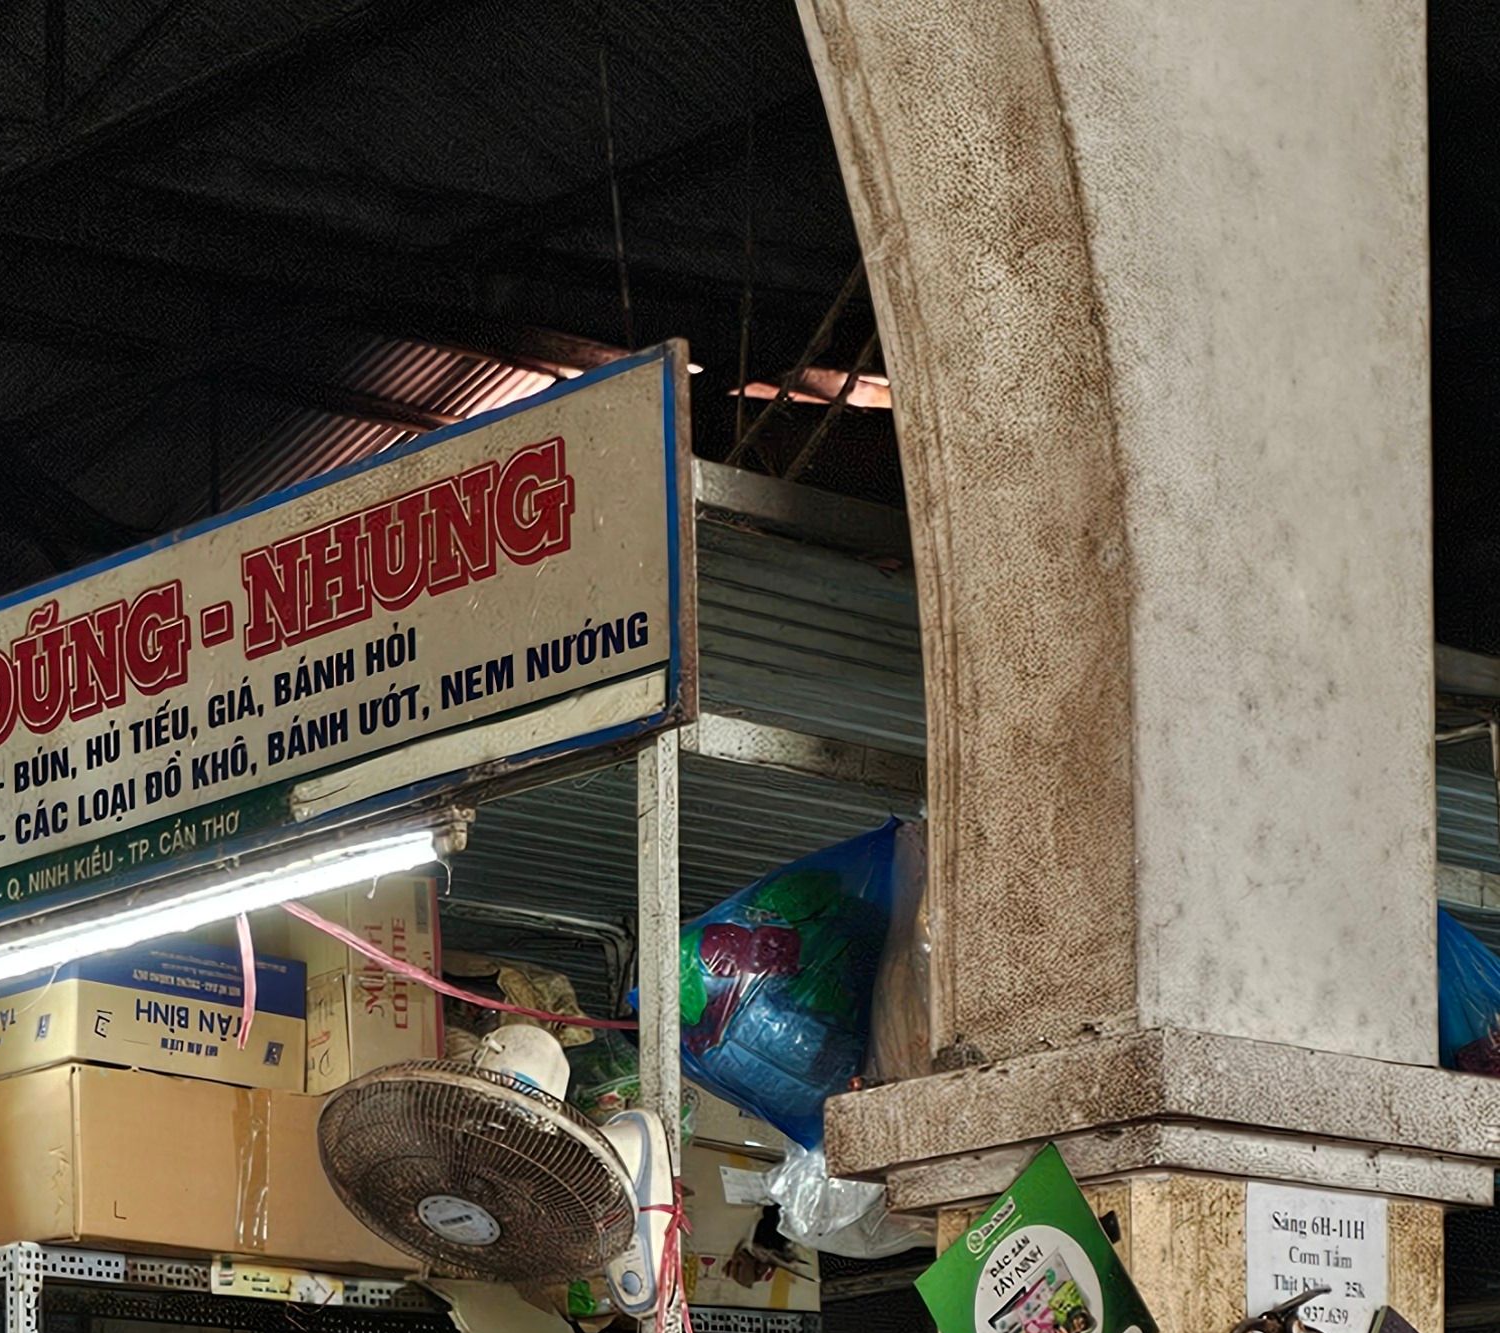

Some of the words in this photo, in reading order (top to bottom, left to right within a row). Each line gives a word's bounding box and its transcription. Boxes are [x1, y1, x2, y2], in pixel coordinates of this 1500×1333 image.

[241, 435, 575, 661] NHUNG
[14, 745, 77, 794] BÚN,
[85, 719, 120, 769] HỦ
[129, 699, 198, 755] TIẾU,
[208, 676, 264, 729] GIÁ,
[274, 647, 354, 708] BÁNH
[365, 622, 416, 677] HỎI
[16, 790, 67, 844] CÁC
[77, 777, 136, 826] LOẠI
[146, 750, 181, 802] ĐỒ
[192, 735, 257, 791] KHÔ,
[268, 704, 348, 766] BÁNH
[359, 682, 431, 736] ƯỚT,
[441, 654, 514, 710] NEM
[527, 611, 648, 682] NƯỚNG
[7, 878, 24, 901] Q.
[28, 863, 70, 895] NINH
[74, 842, 113, 880] KIỀU
[127, 839, 153, 864] TP.
[201, 810, 240, 843] THƠ
[134, 998, 190, 1034] BÌNH
[1272, 1211, 1307, 1239] Sáng
[1311, 1216, 1365, 1240] 6H-11H
